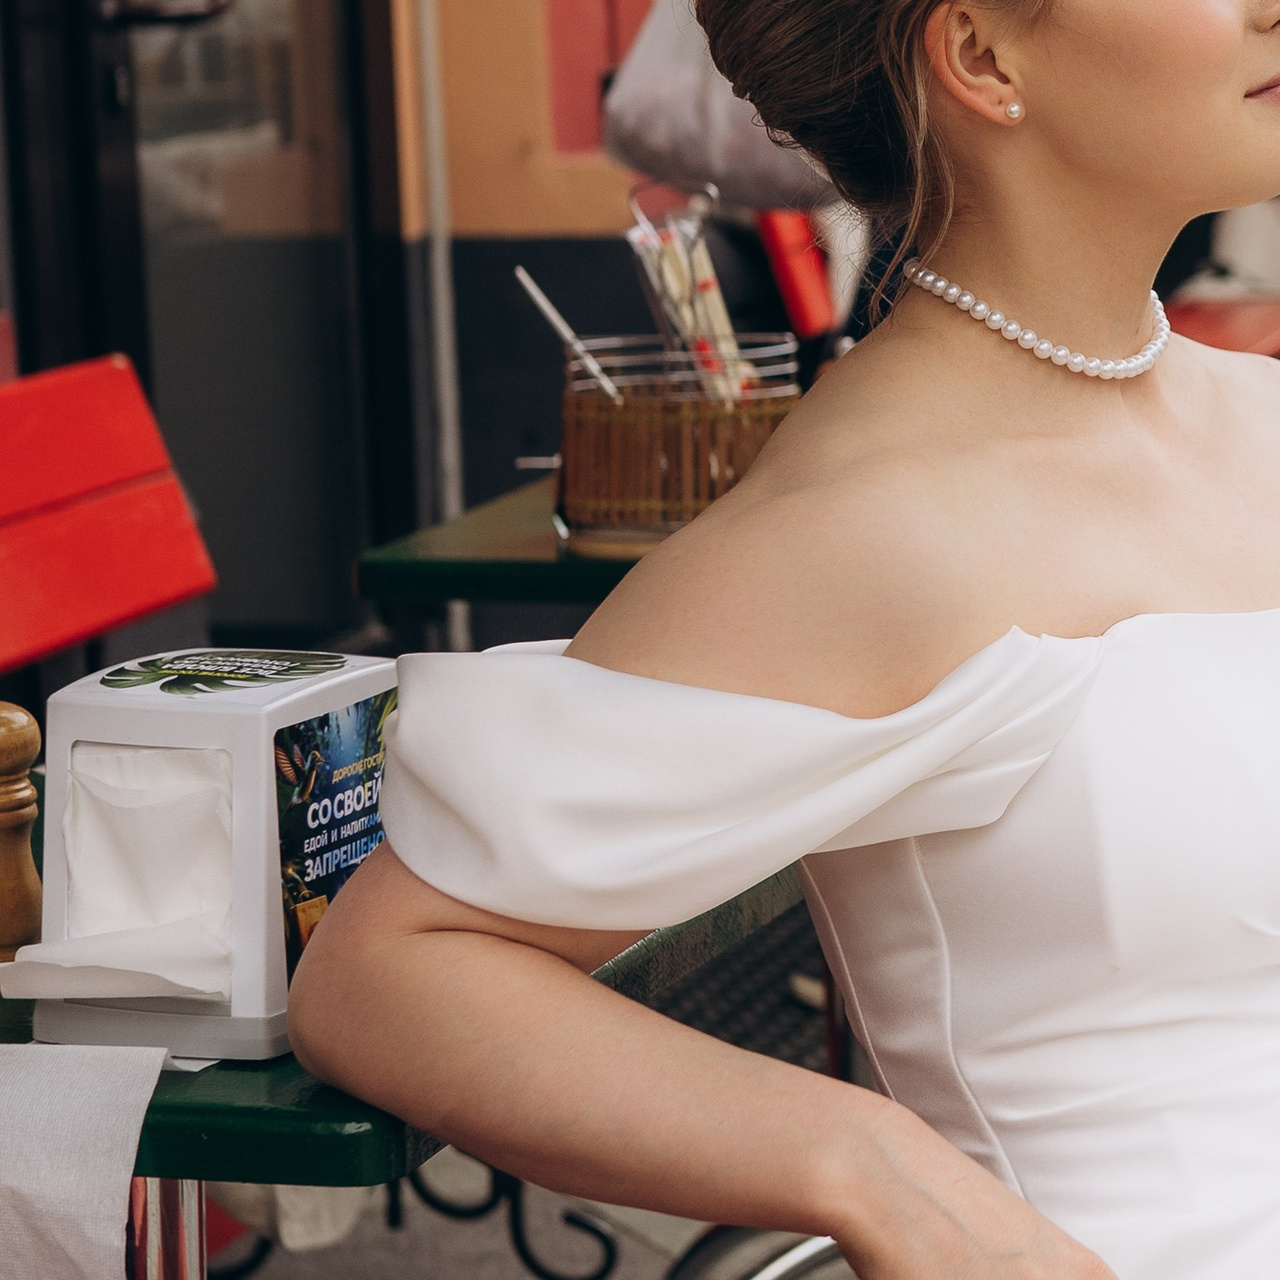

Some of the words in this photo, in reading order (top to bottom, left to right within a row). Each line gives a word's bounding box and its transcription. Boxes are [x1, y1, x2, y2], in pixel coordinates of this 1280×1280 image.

[307, 798, 332, 829] СО
[333, 771, 382, 819] СВОЕЙ
[304, 830, 328, 854] ЕДОЙ
[331, 829, 338, 843] И
[340, 811, 382, 839] НАПИТКАМ
[304, 830, 385, 882] ЗАПРЕЩЕНО
